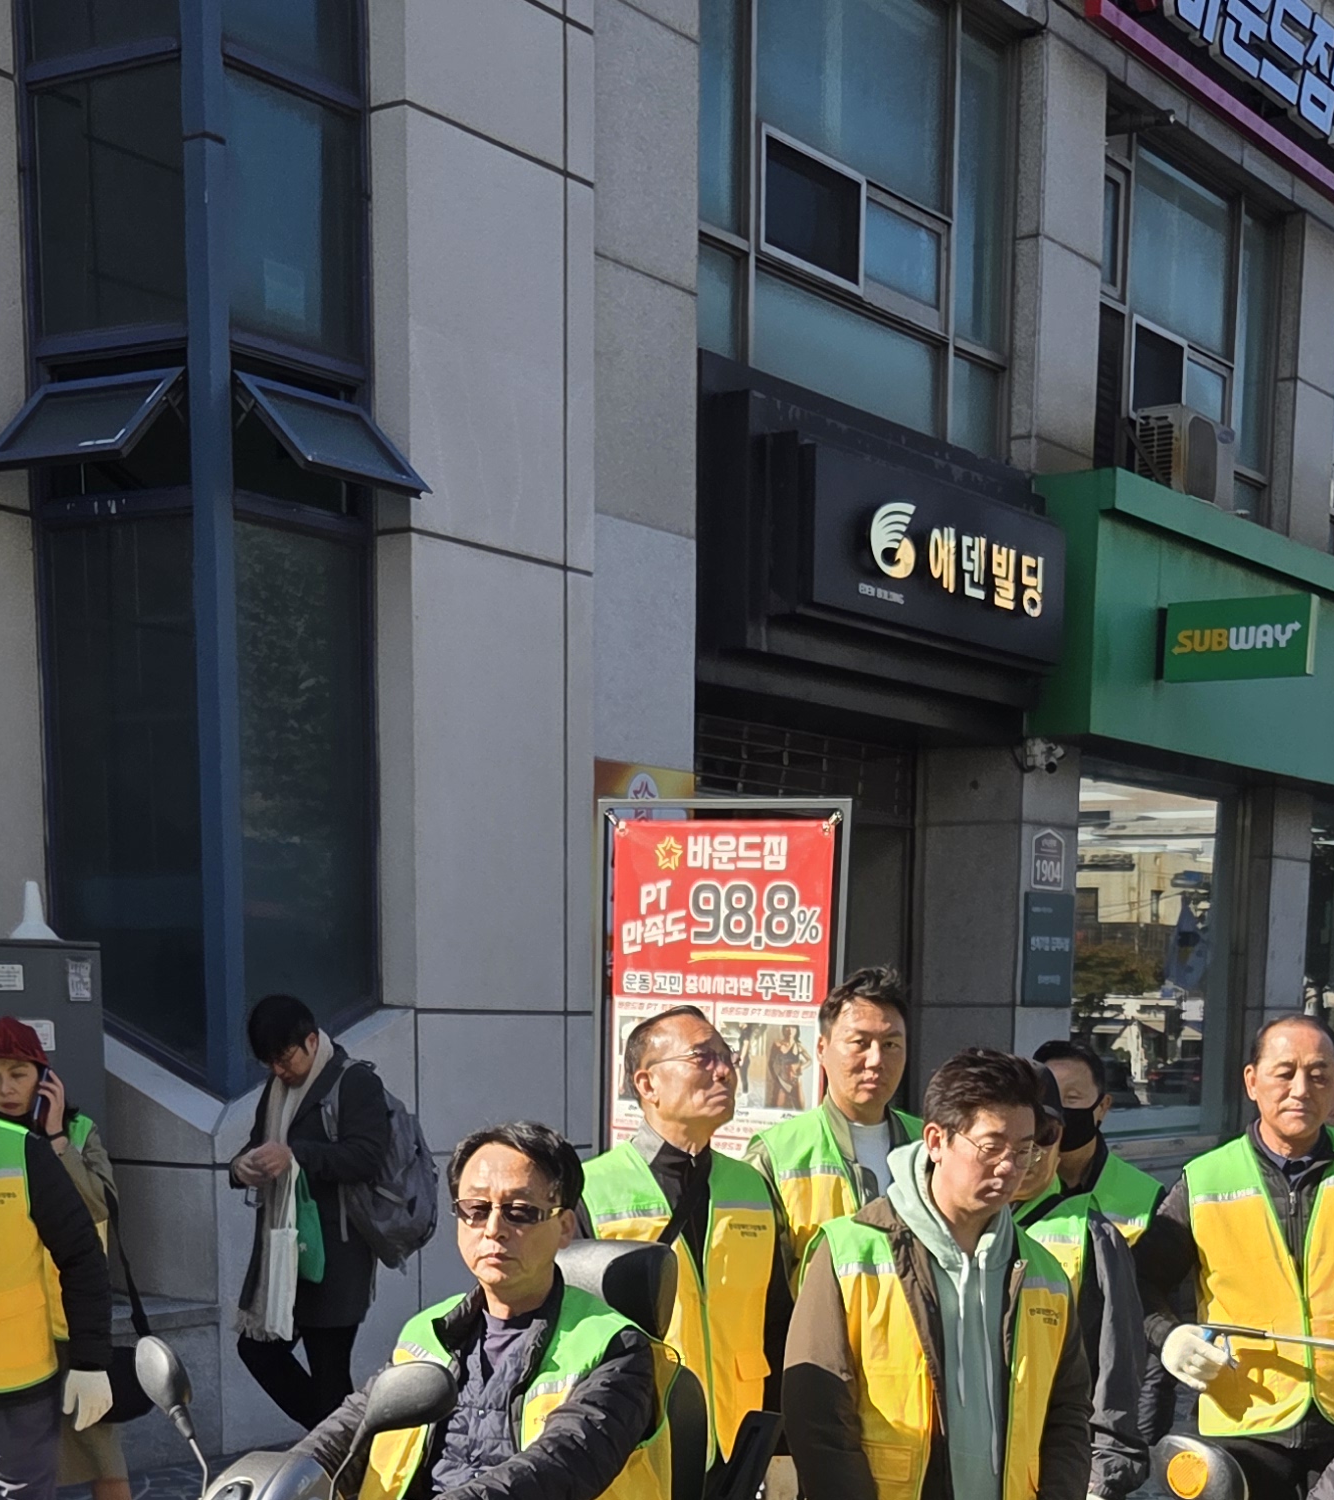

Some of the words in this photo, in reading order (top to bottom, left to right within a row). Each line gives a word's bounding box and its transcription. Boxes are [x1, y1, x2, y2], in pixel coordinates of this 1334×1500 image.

[929, 527, 1044, 618] 에덴빌딩
[1171, 621, 1302, 656] SUBWAY
[687, 835, 788, 871] 바운드짐
[1036, 859, 1062, 883] 1904
[640, 880, 672, 915] PT
[689, 879, 823, 950] 98.8%
[622, 910, 687, 954] 만족도
[623, 971, 652, 993] 운동
[653, 973, 683, 994] 고민
[685, 975, 753, 997] 중이시라면
[756, 969, 814, 1003] 주목!!
